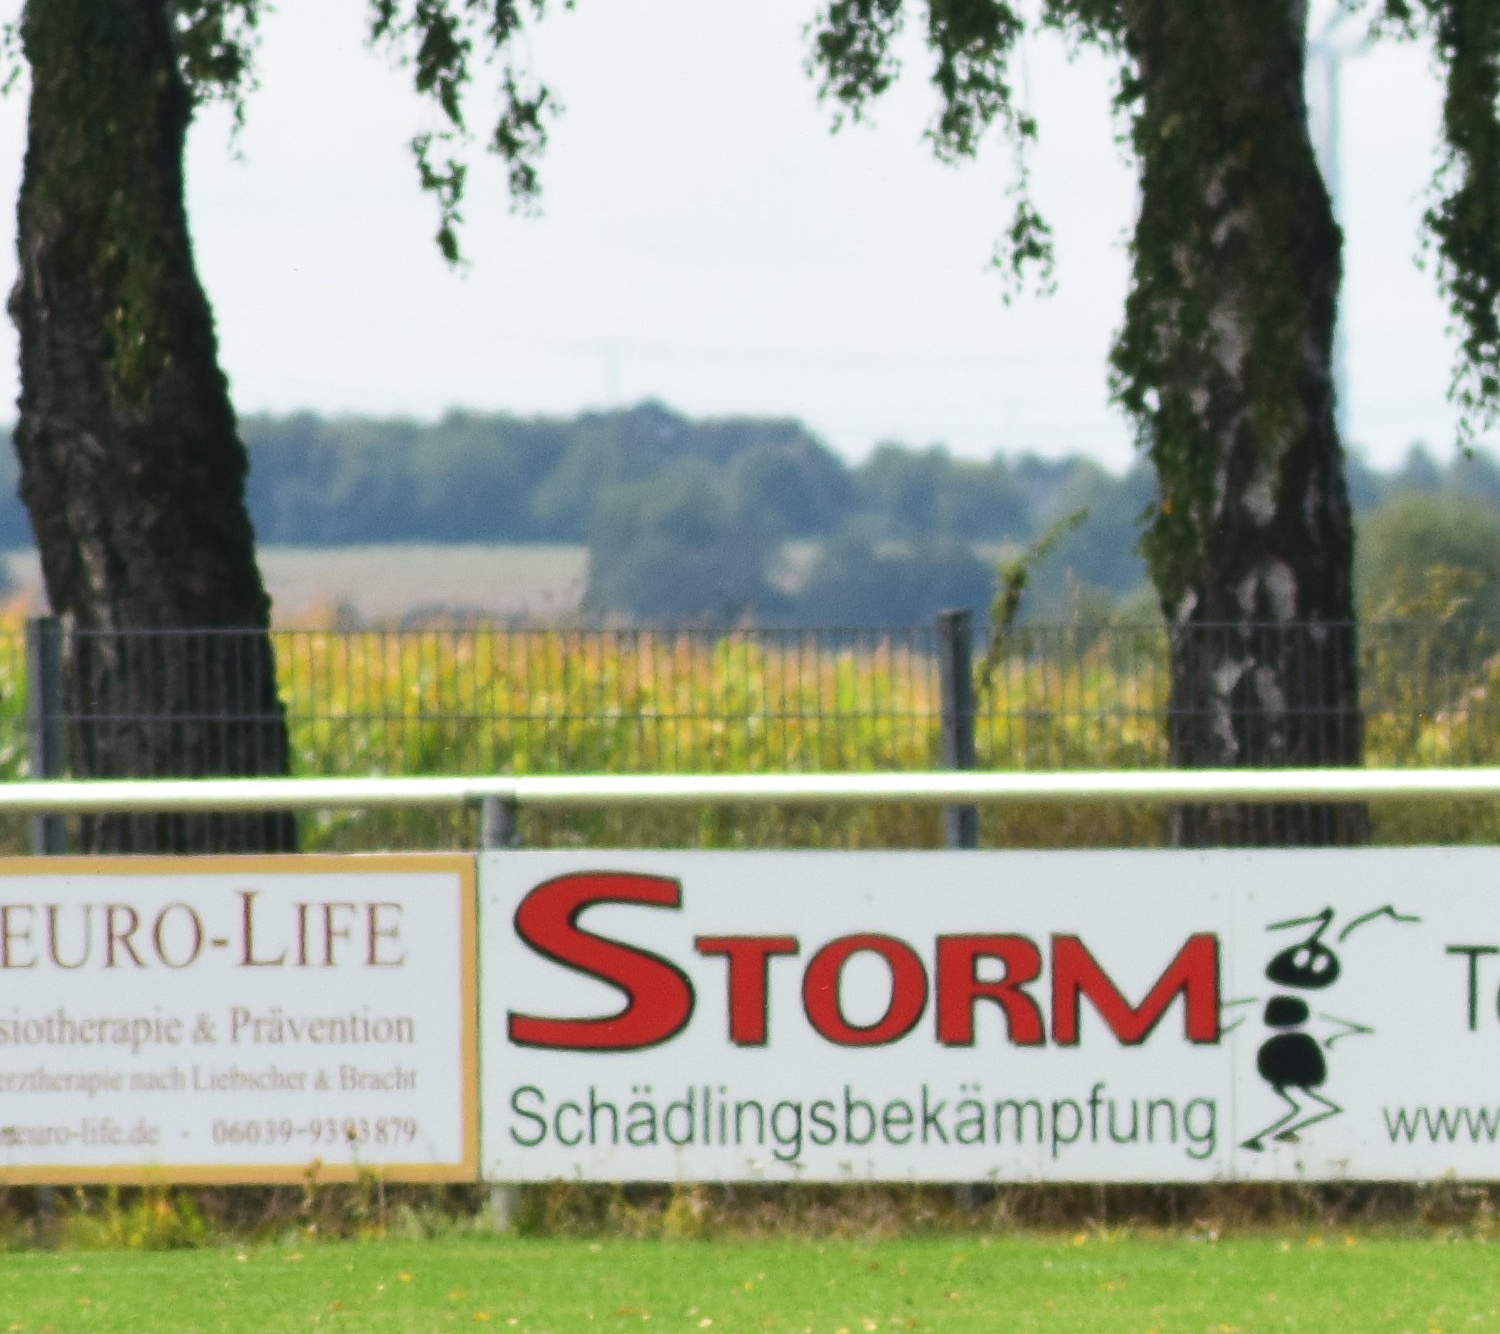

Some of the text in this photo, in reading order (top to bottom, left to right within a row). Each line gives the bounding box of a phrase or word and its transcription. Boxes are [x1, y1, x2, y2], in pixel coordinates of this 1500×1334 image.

[507, 870, 1221, 1053] STORM
[192, 1013, 217, 1044] &
[230, 1005, 415, 1044] Prävention
[129, 1064, 186, 1091] nach
[192, 1064, 308, 1092] Liebscher
[339, 1063, 417, 1092] Bracht
[508, 1082, 1218, 1161] Schädlingsbekämpfung
